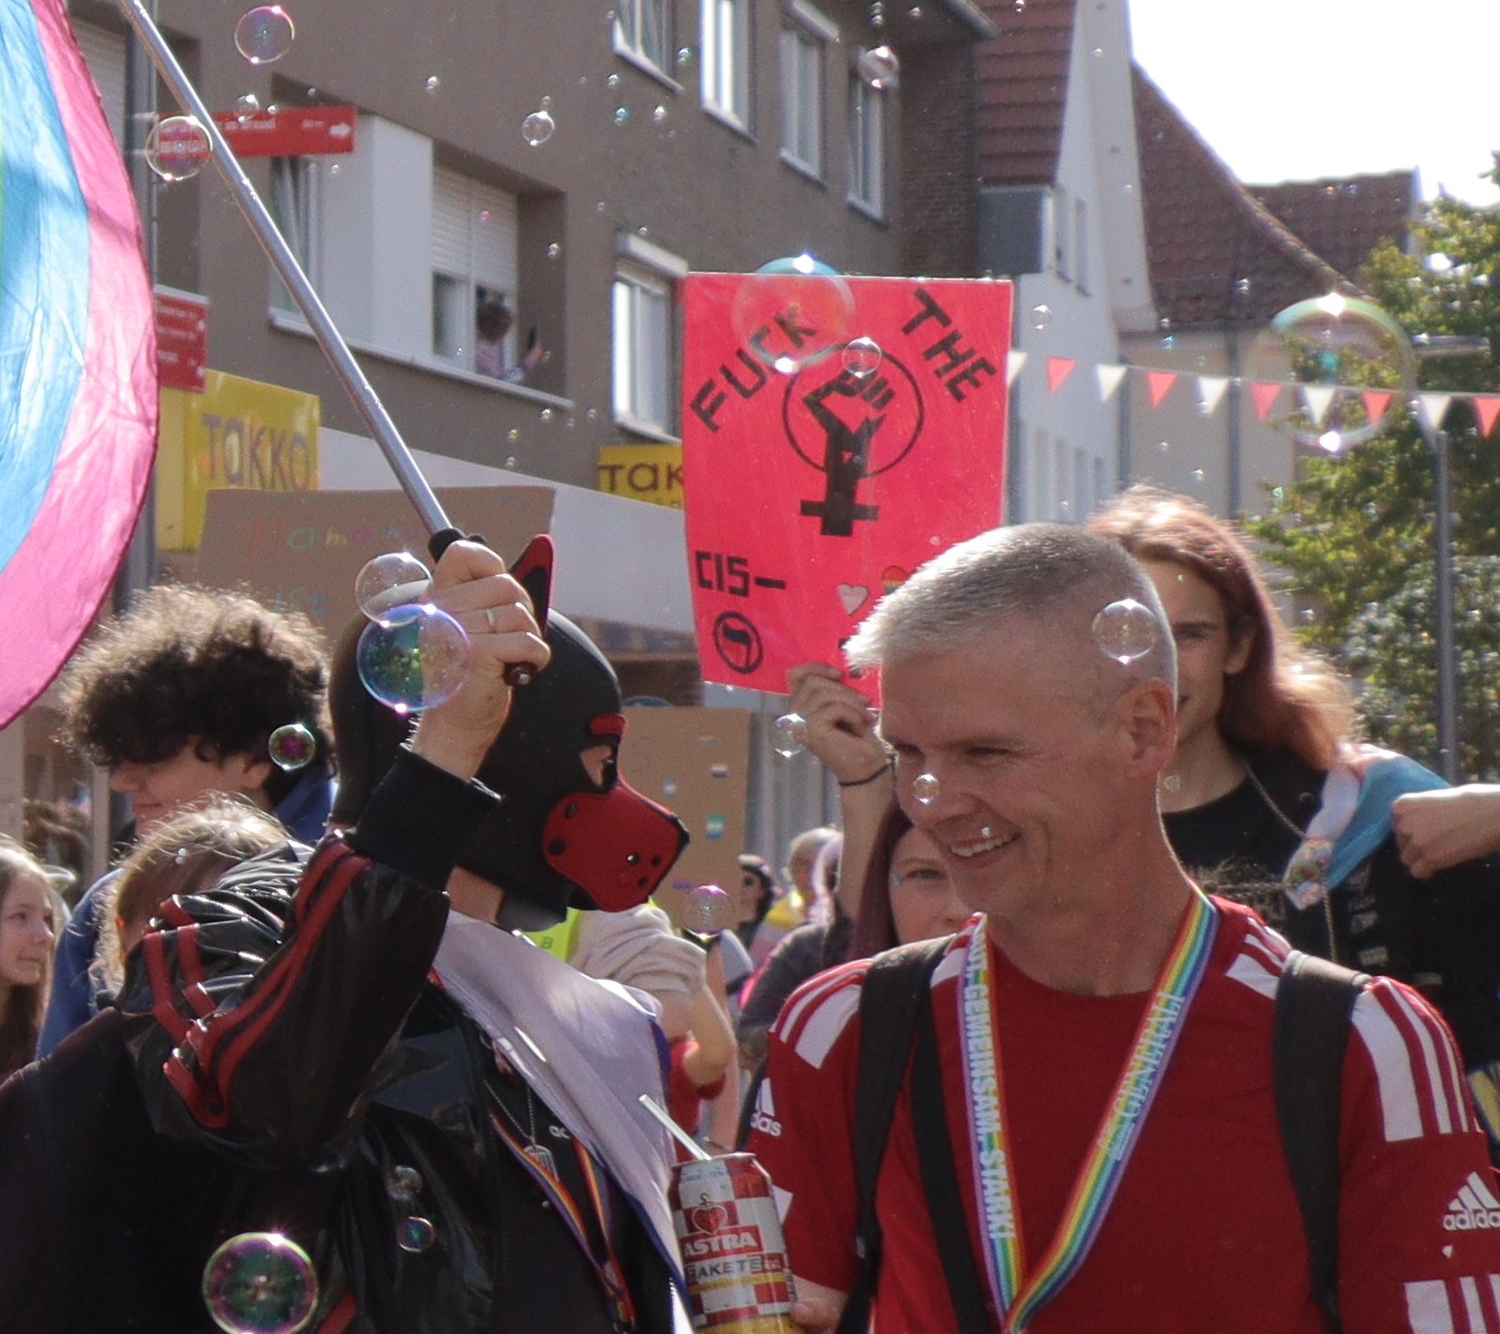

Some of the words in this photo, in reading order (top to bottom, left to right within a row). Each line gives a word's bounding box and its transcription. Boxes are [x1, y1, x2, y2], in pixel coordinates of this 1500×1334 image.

[690, 305, 816, 433] FUCK
[900, 288, 996, 403] THE
[1113, 991, 1185, 1120] GENERALI
[684, 1232, 757, 1256] ASTRA
[980, 1149, 1016, 1239] STARK!
[1443, 1208, 1500, 1231] adida
